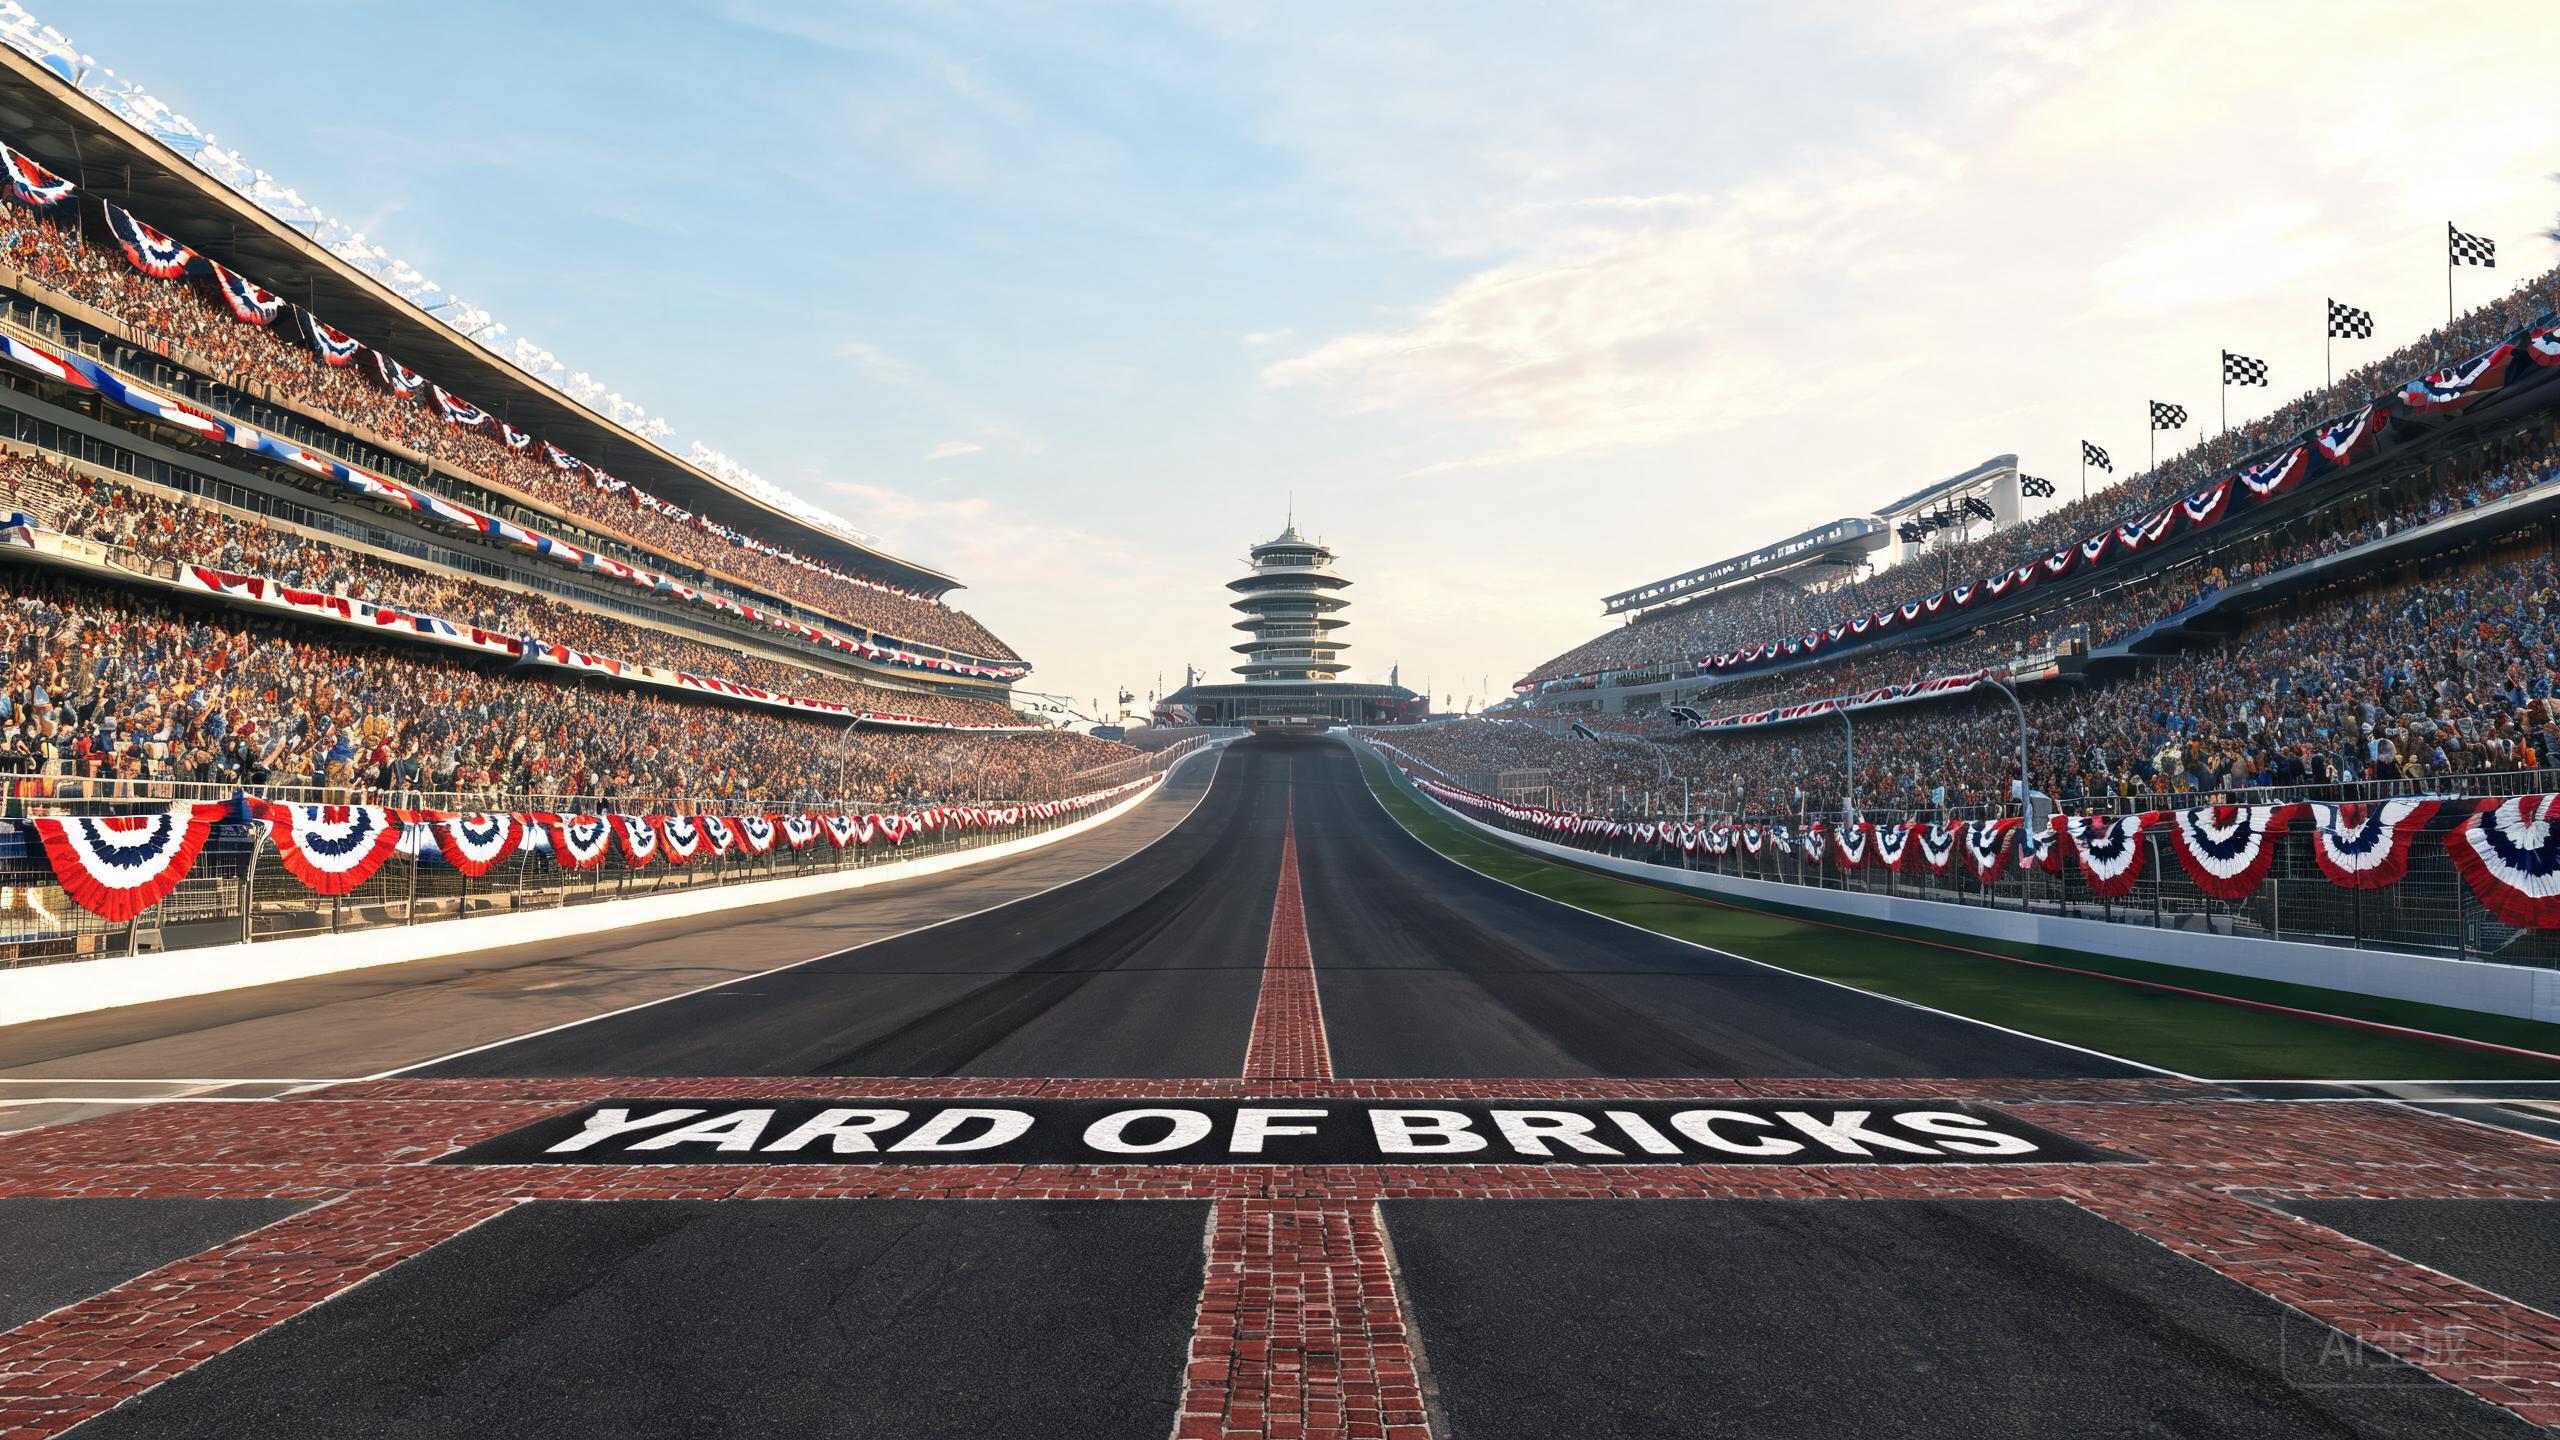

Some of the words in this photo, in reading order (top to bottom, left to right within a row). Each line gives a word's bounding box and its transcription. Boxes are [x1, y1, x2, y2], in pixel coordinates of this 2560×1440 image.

[545, 1109, 1034, 1153] YARD
[1083, 1109, 1328, 1153] OF
[1369, 1110, 2040, 1157] BRICKS
